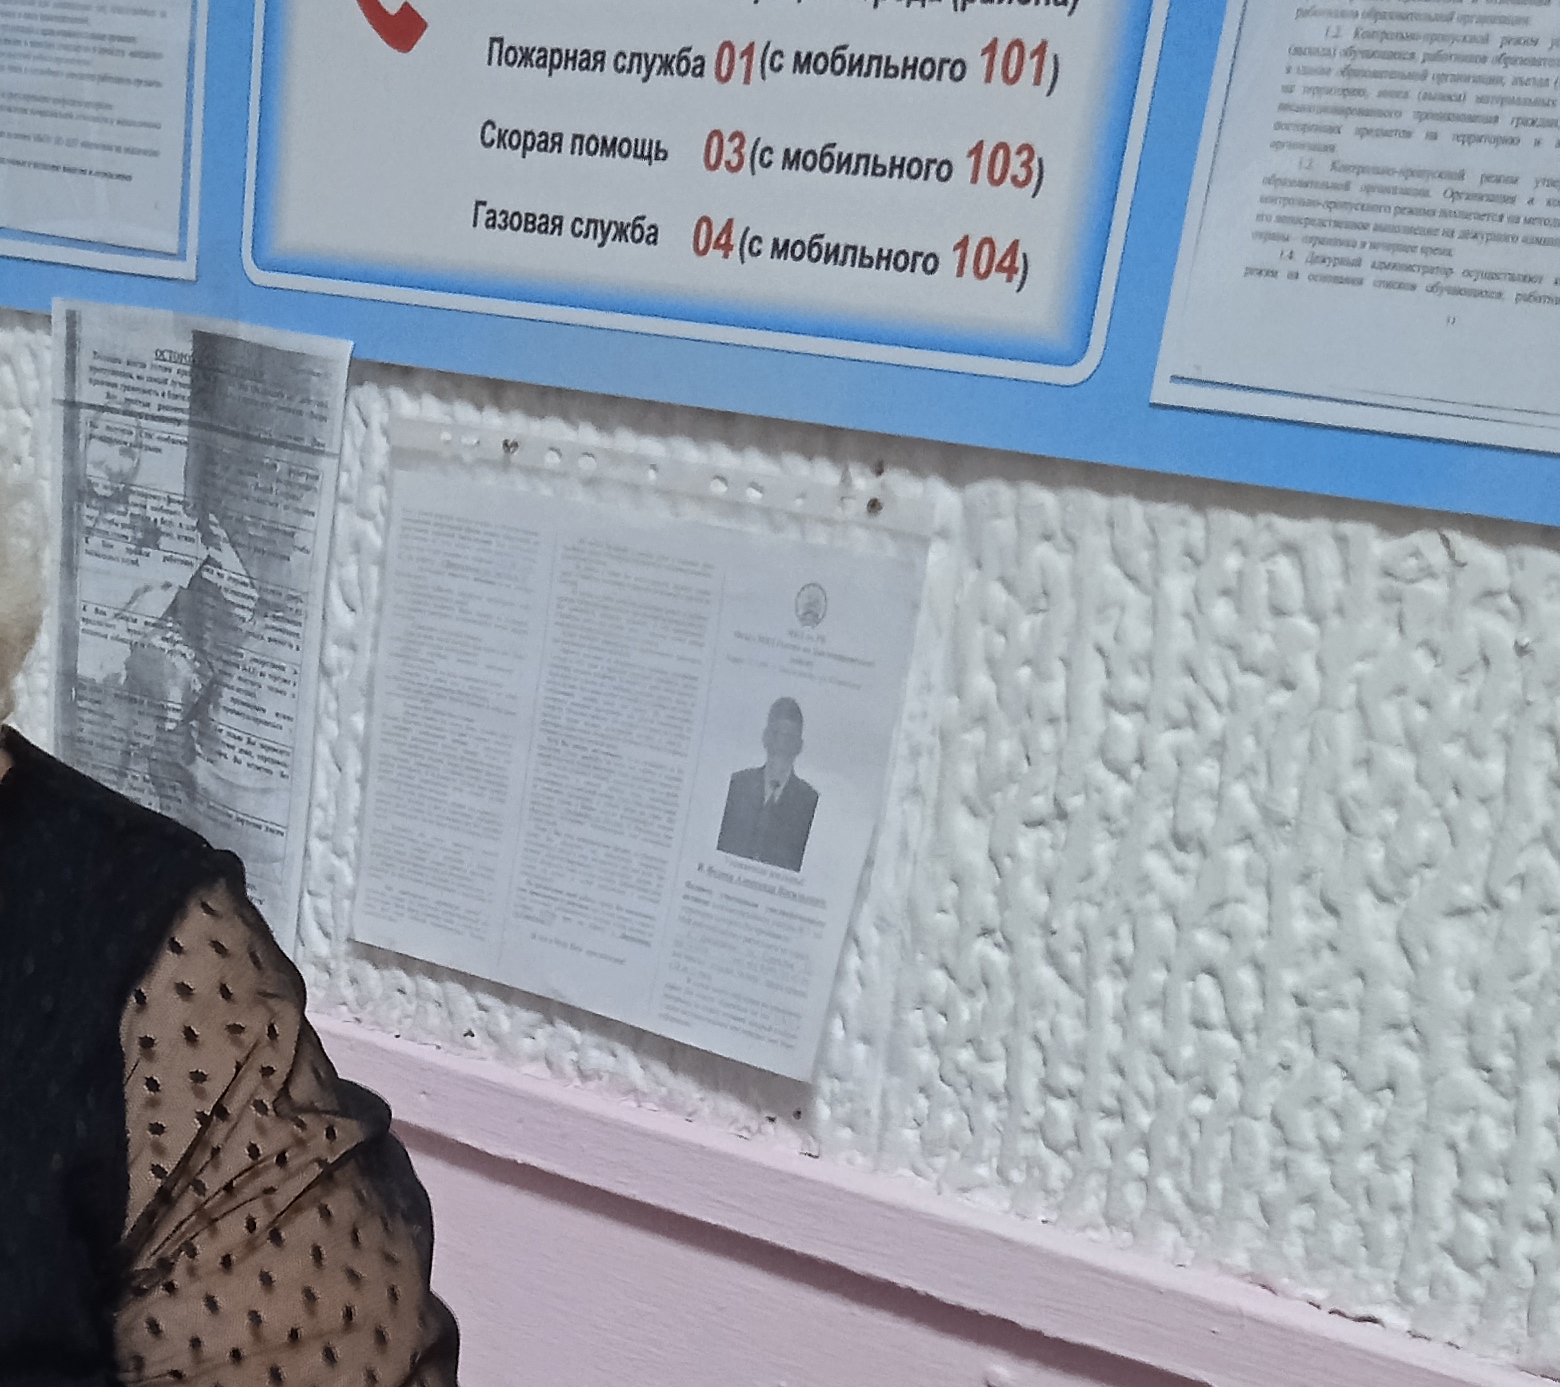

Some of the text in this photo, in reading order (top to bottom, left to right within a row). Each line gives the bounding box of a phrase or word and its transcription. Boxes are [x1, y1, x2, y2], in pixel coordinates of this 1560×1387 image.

[487, 36, 606, 77] Пожарная
[612, 45, 706, 83] служба
[793, 44, 967, 83] мобильного
[480, 119, 563, 159] Скорая
[570, 131, 669, 166] помощь
[782, 142, 954, 183] мобильного
[472, 200, 563, 237] Газовая
[570, 215, 660, 249] служба
[770, 233, 939, 276] мобильного
